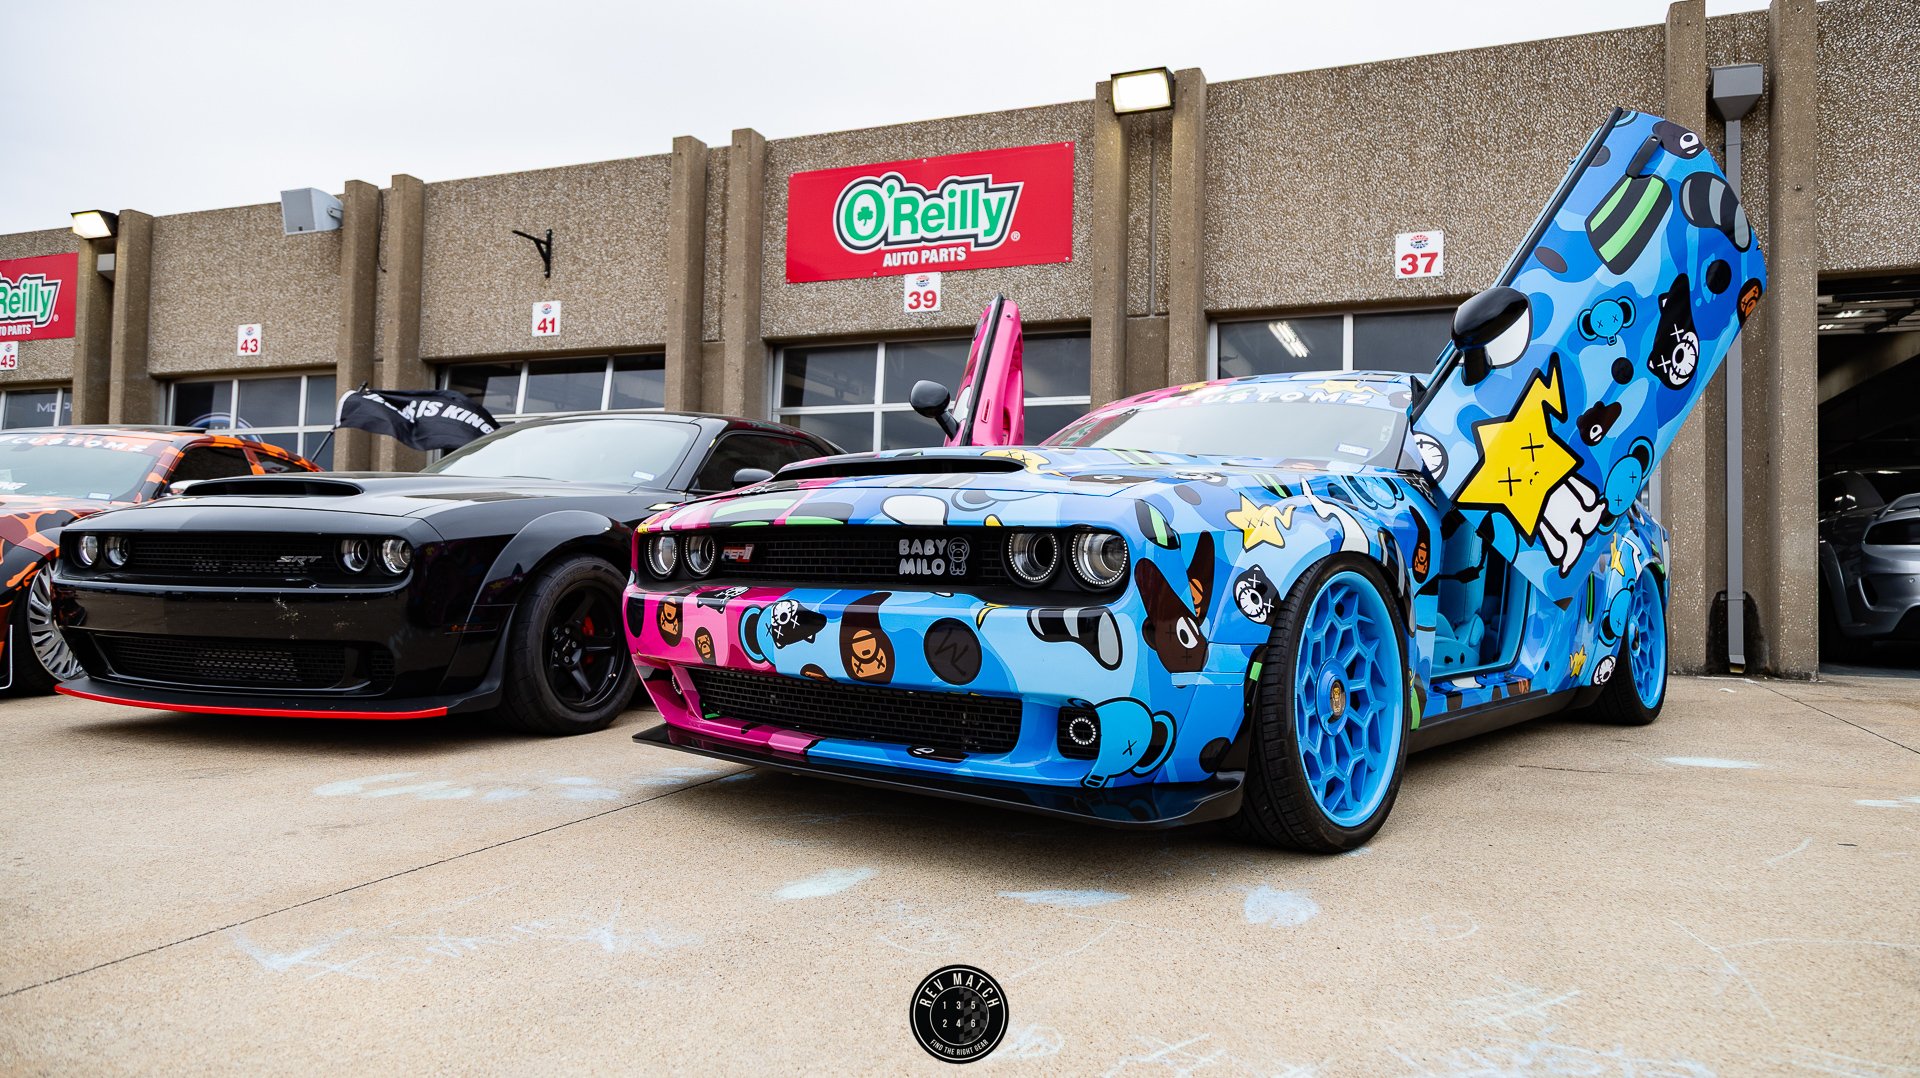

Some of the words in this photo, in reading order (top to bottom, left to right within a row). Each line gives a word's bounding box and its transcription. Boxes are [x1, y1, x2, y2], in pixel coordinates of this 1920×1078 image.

[844, 183, 1007, 242] O'Reilly
[882, 250, 921, 268] AUTO
[921, 246, 967, 265] PARTS
[1400, 252, 1438, 275] 37
[908, 289, 938, 311] 39
[7, 324, 32, 336] PARTS
[537, 317, 556, 334] 41
[240, 338, 259, 353] 43
[0, 354, 16, 368] 45
[415, 400, 444, 419] IS
[441, 404, 495, 435] KING
[898, 538, 948, 556] BABY
[276, 555, 322, 567] SRT
[898, 558, 946, 576] MILO
